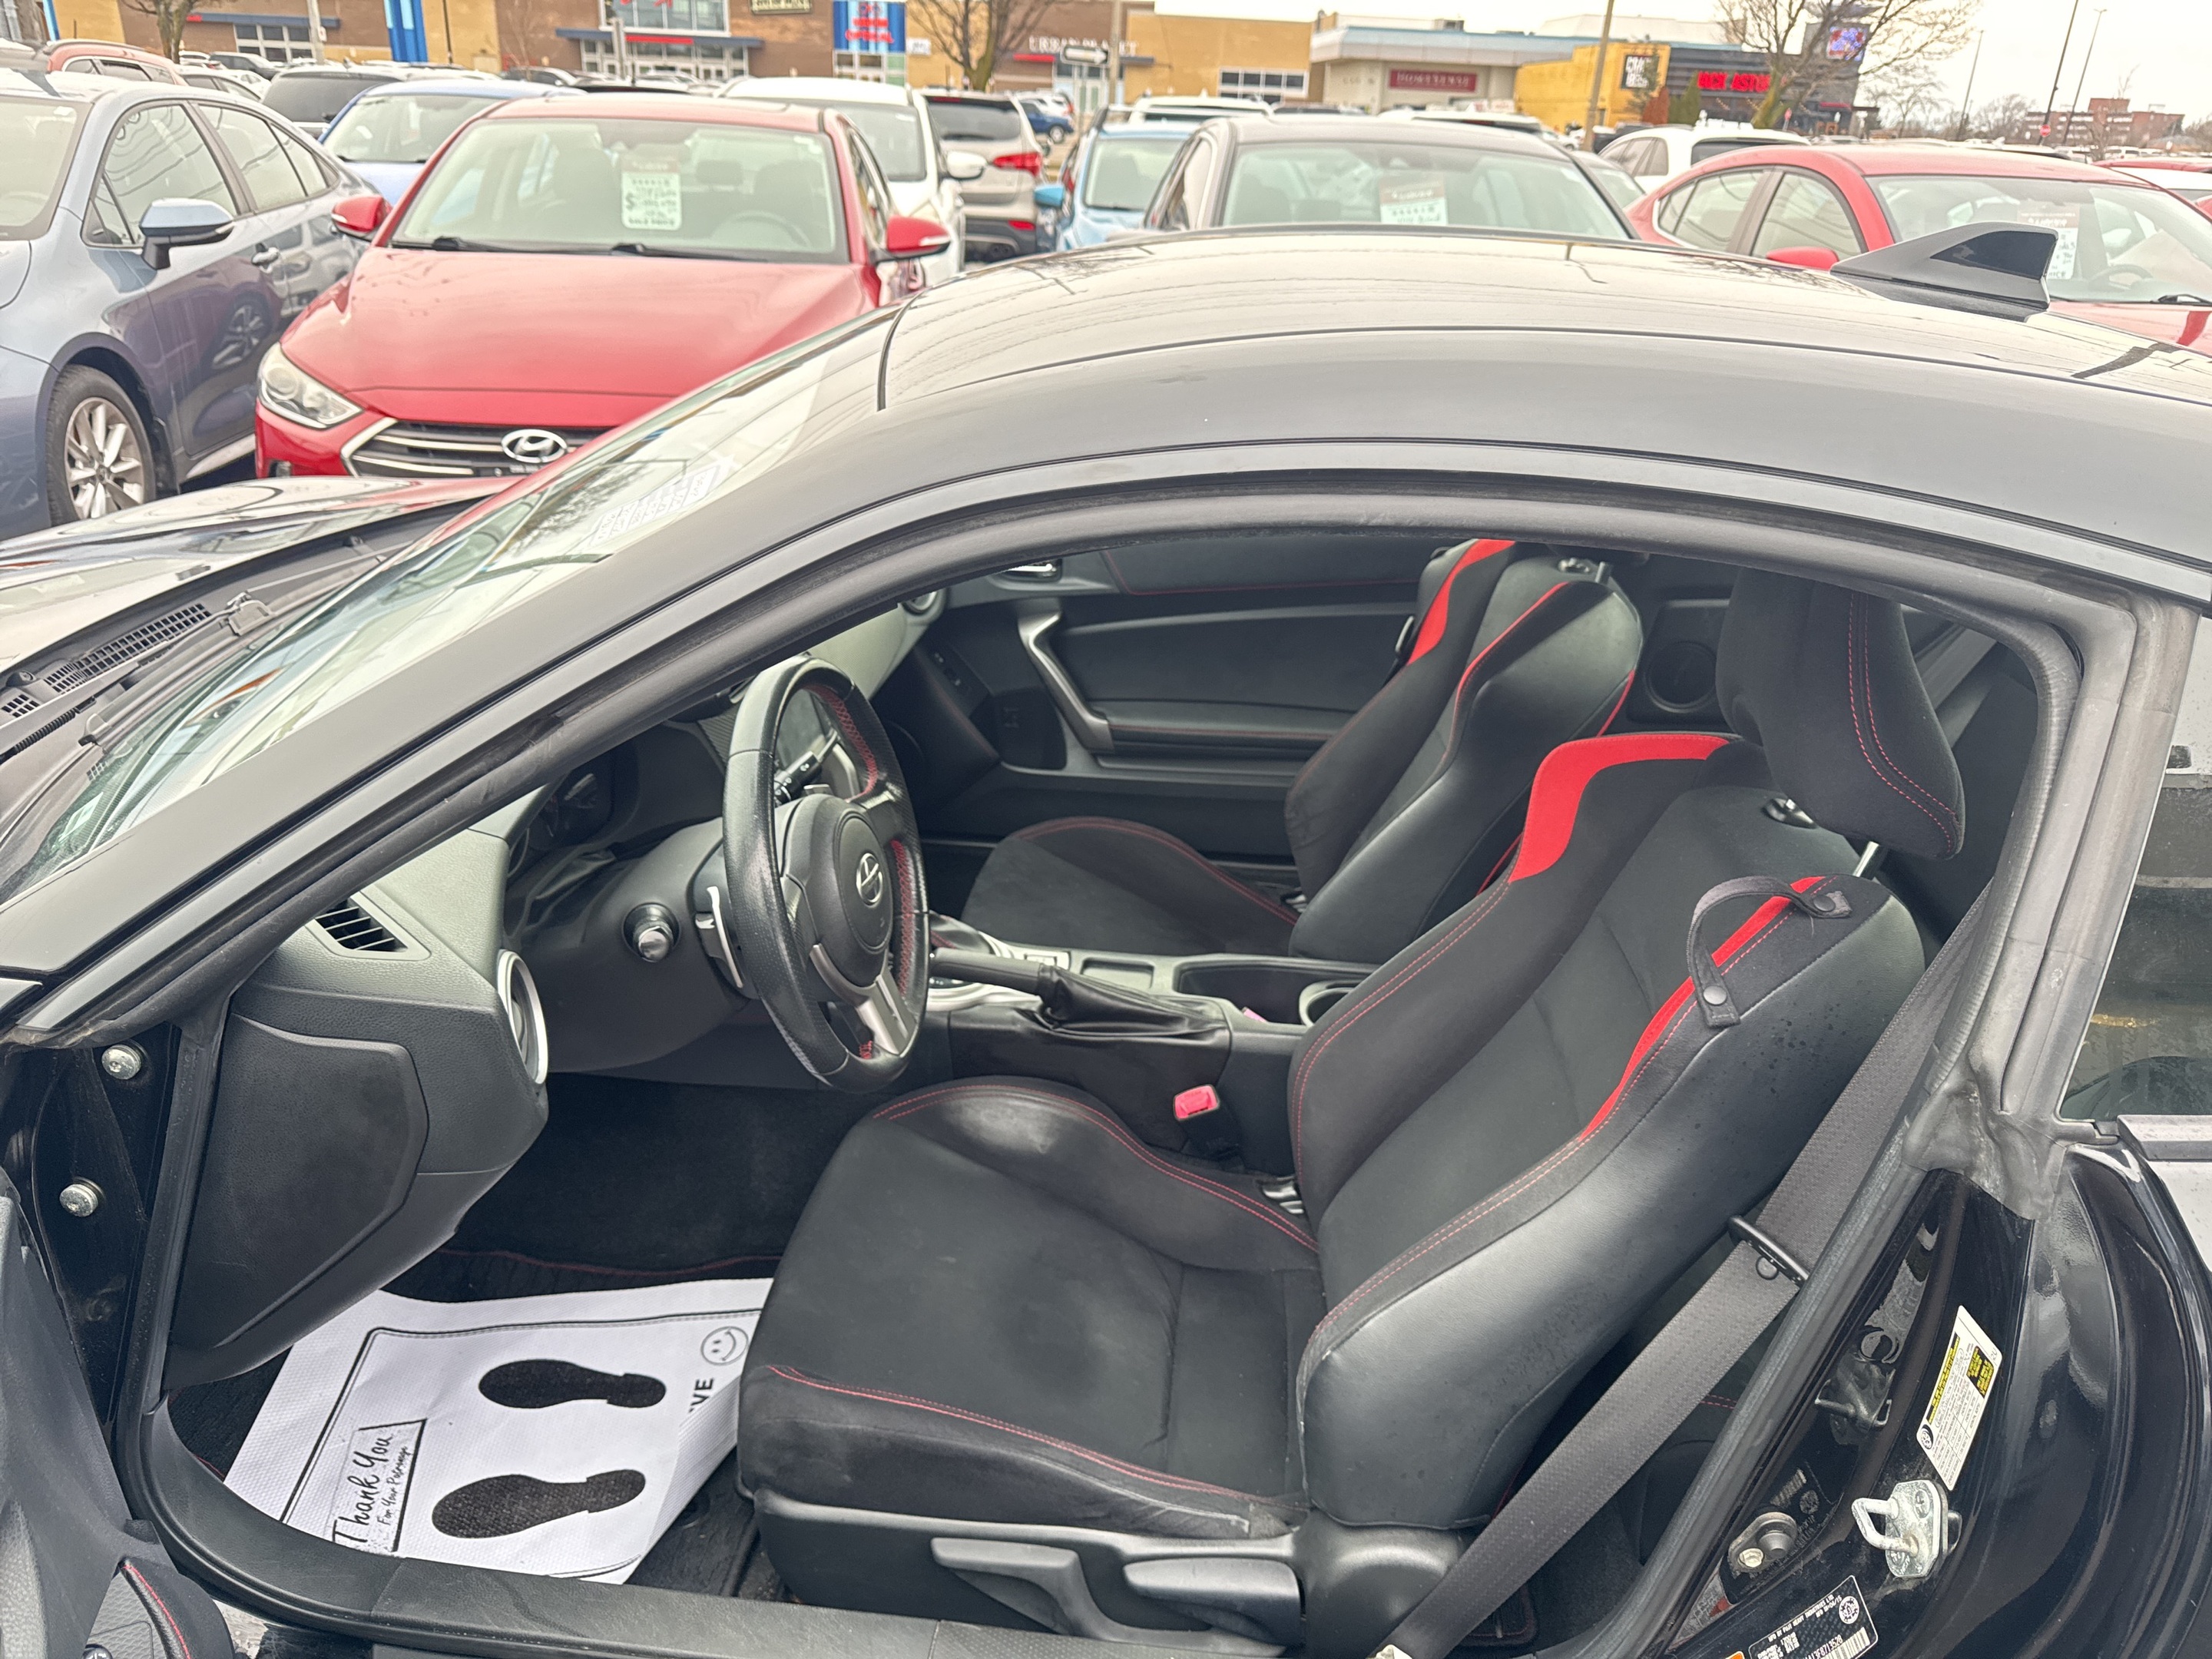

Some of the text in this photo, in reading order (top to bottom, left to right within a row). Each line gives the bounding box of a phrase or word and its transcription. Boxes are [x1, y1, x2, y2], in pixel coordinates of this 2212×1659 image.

[1082, 37, 1139, 57] PLAET
[689, 1378, 714, 1412] VE
[332, 1434, 393, 1543] Thank You
[381, 1486, 399, 1506] Your
[376, 1508, 393, 1525] For
